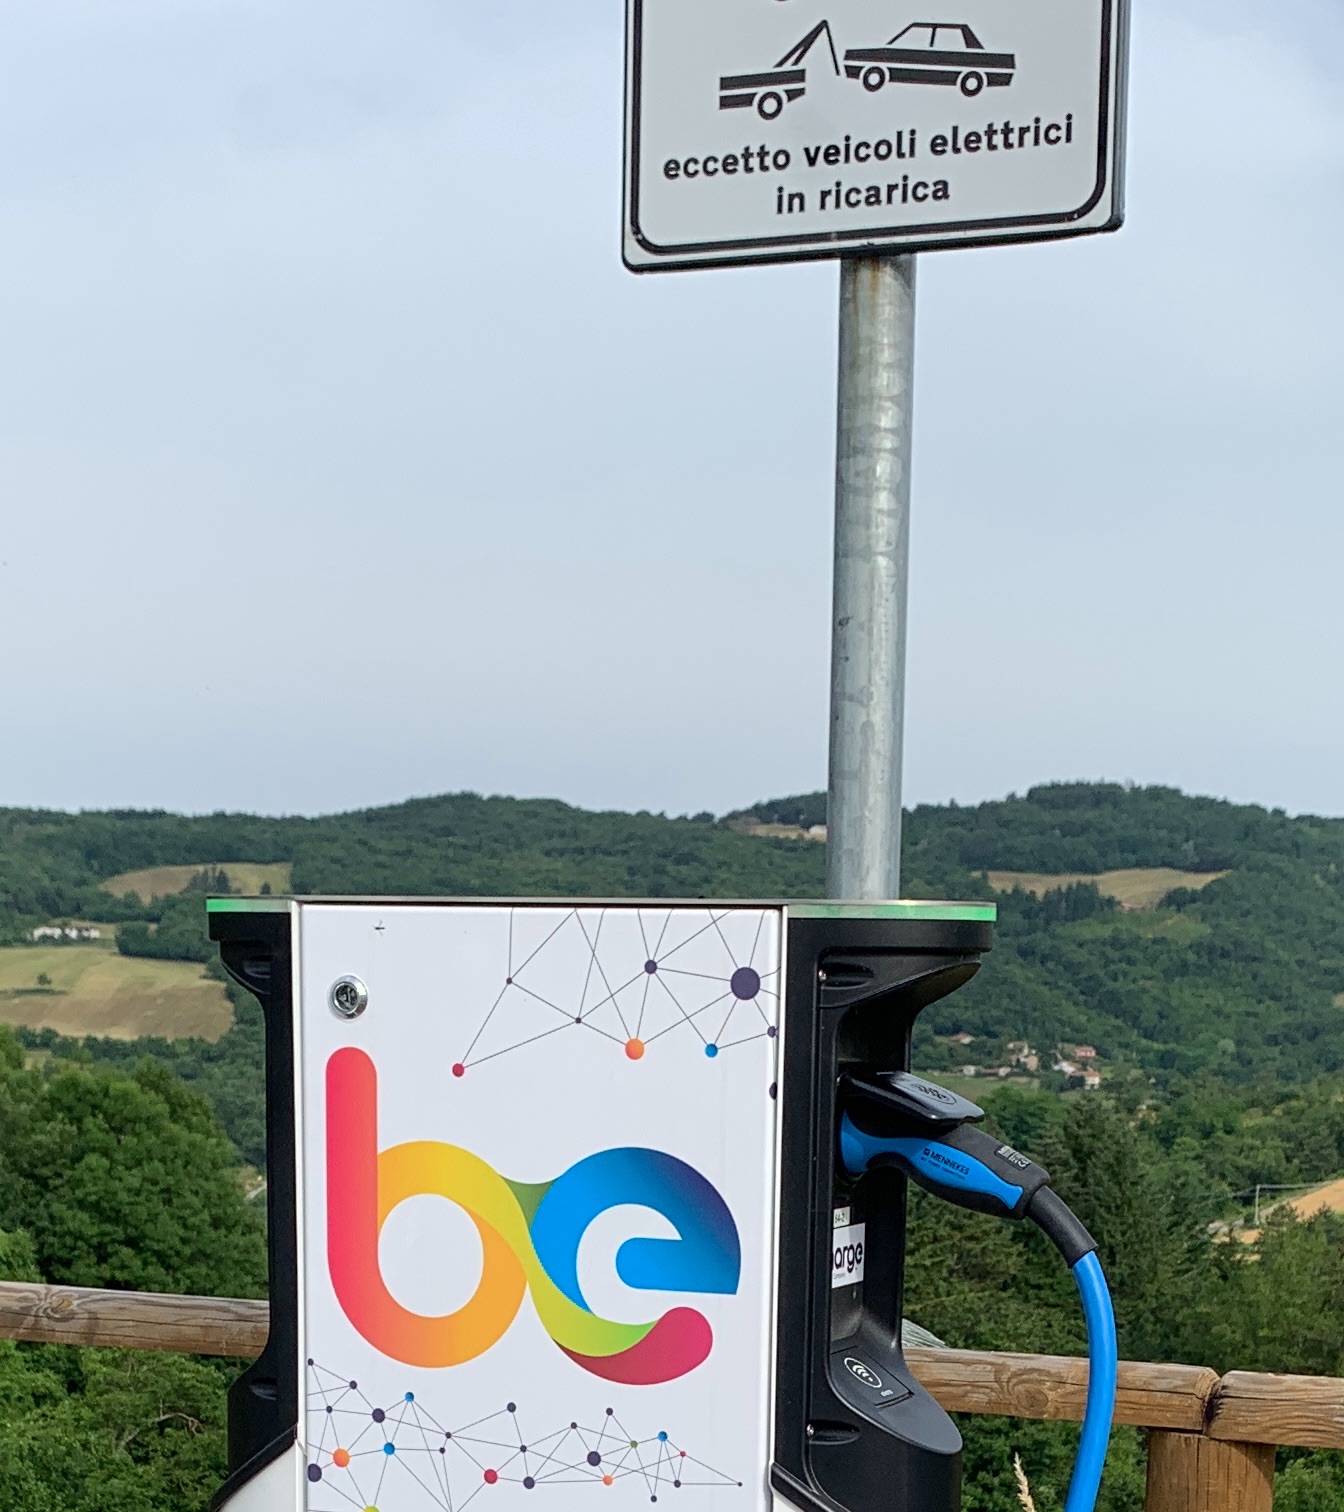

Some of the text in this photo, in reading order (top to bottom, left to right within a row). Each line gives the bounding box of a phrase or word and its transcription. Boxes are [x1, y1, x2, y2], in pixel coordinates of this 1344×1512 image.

[662, 113, 1074, 180] eccetto veicoli elettrici
[775, 174, 950, 215] in ricarica
[930, 1150, 971, 1176] MENNEKES
[325, 1046, 741, 1386] be
